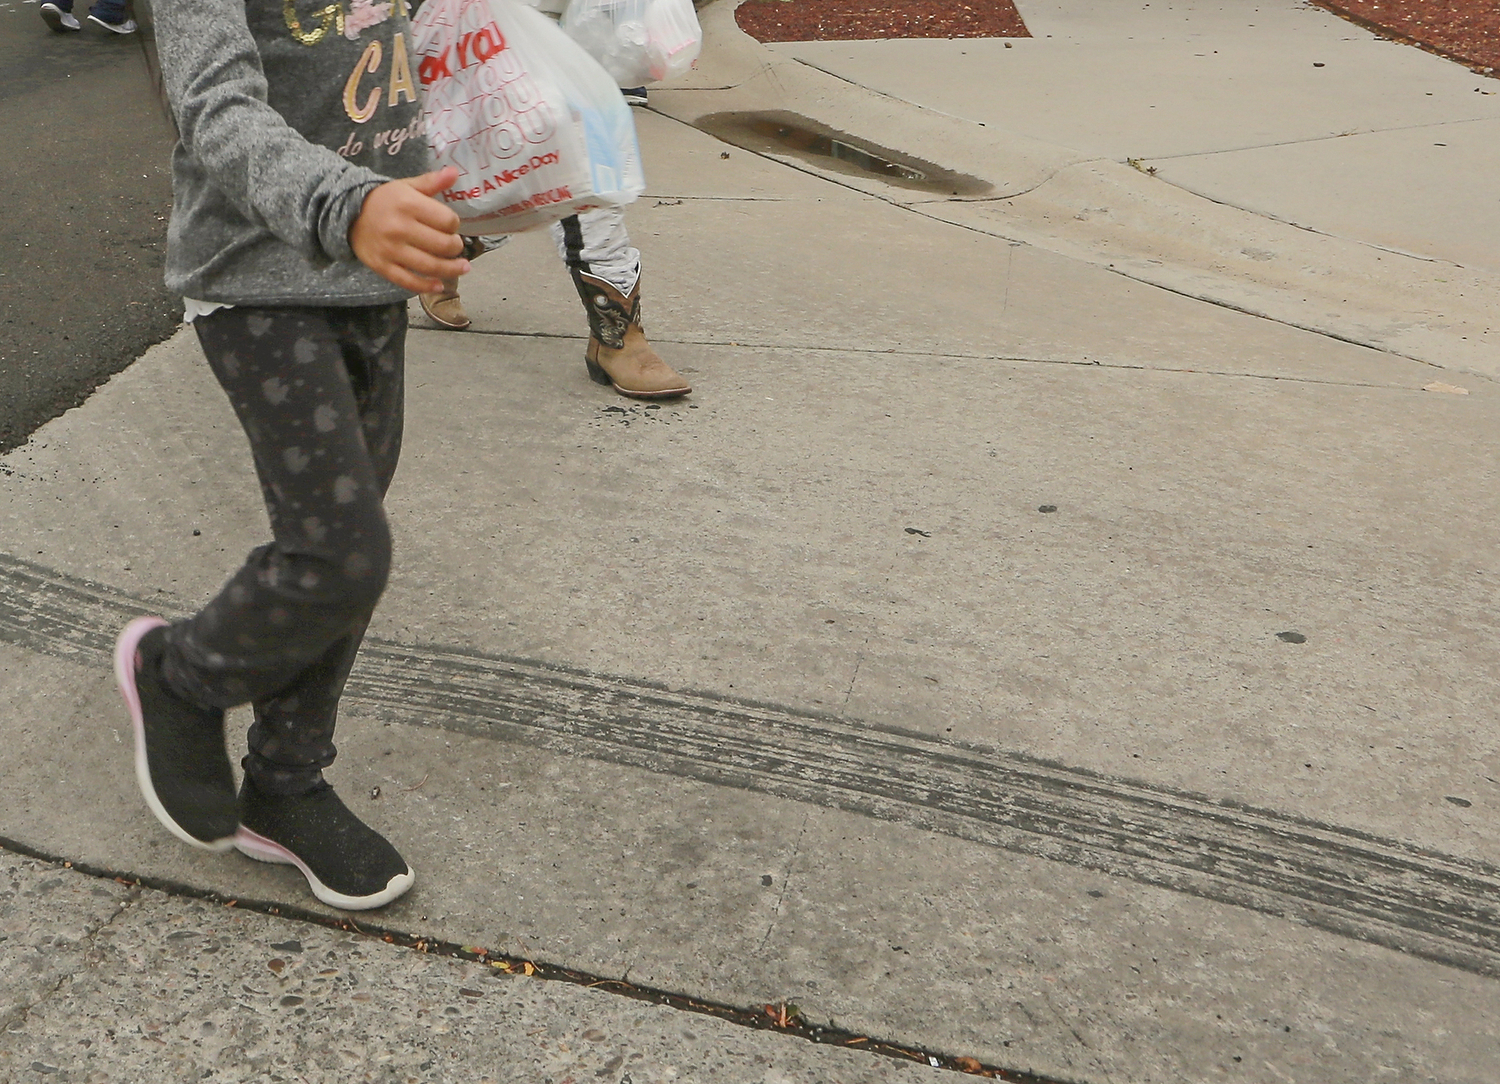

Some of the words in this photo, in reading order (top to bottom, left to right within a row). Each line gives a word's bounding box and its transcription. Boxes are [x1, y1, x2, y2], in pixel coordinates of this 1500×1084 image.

[342, 32, 417, 124] CA
[337, 132, 363, 157] do
[466, 101, 557, 169] YOU
[442, 187, 481, 203] Have
[483, 179, 496, 194] A
[494, 164, 530, 187] Nice
[529, 149, 560, 170] Day
